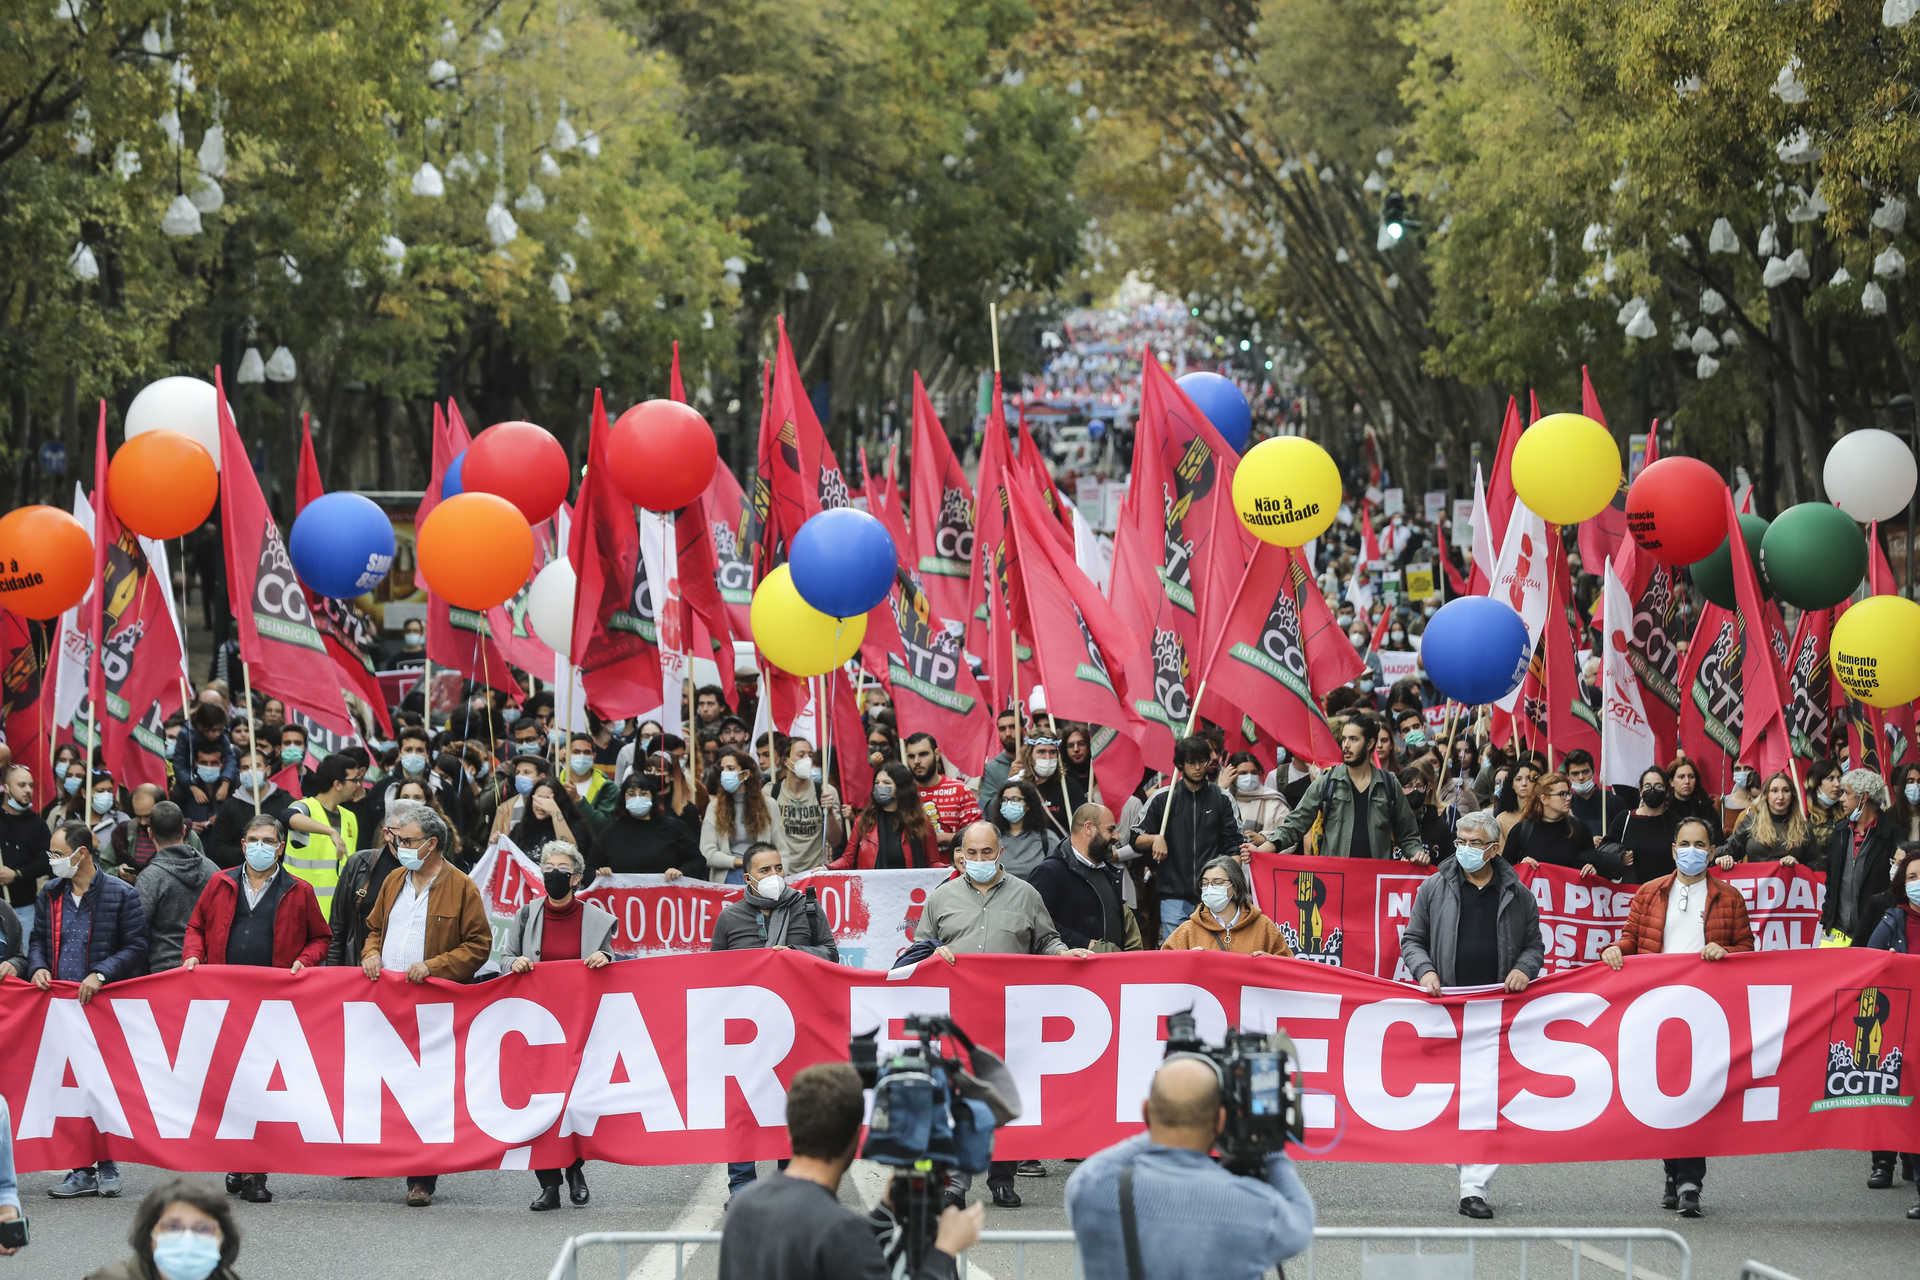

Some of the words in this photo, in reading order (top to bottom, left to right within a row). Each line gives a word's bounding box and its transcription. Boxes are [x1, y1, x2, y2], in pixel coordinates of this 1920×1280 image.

[1254, 497, 1280, 512] Não
[1283, 496, 1293, 511] à
[1243, 503, 1320, 526] caducidade
[0, 572, 44, 592] cidade
[1837, 651, 1877, 668] Aumento
[1857, 667, 1877, 678] dos
[625, 896, 646, 943] O
[656, 896, 713, 951] QUE
[17, 985, 796, 1170] AVANÇAR
[1003, 983, 1792, 1131] PRECISO!
[1827, 1070, 1899, 1095] CGTP
[1814, 1097, 1869, 1111] INTERSINDICAL
[1870, 1096, 1907, 1106] NACIONAL
